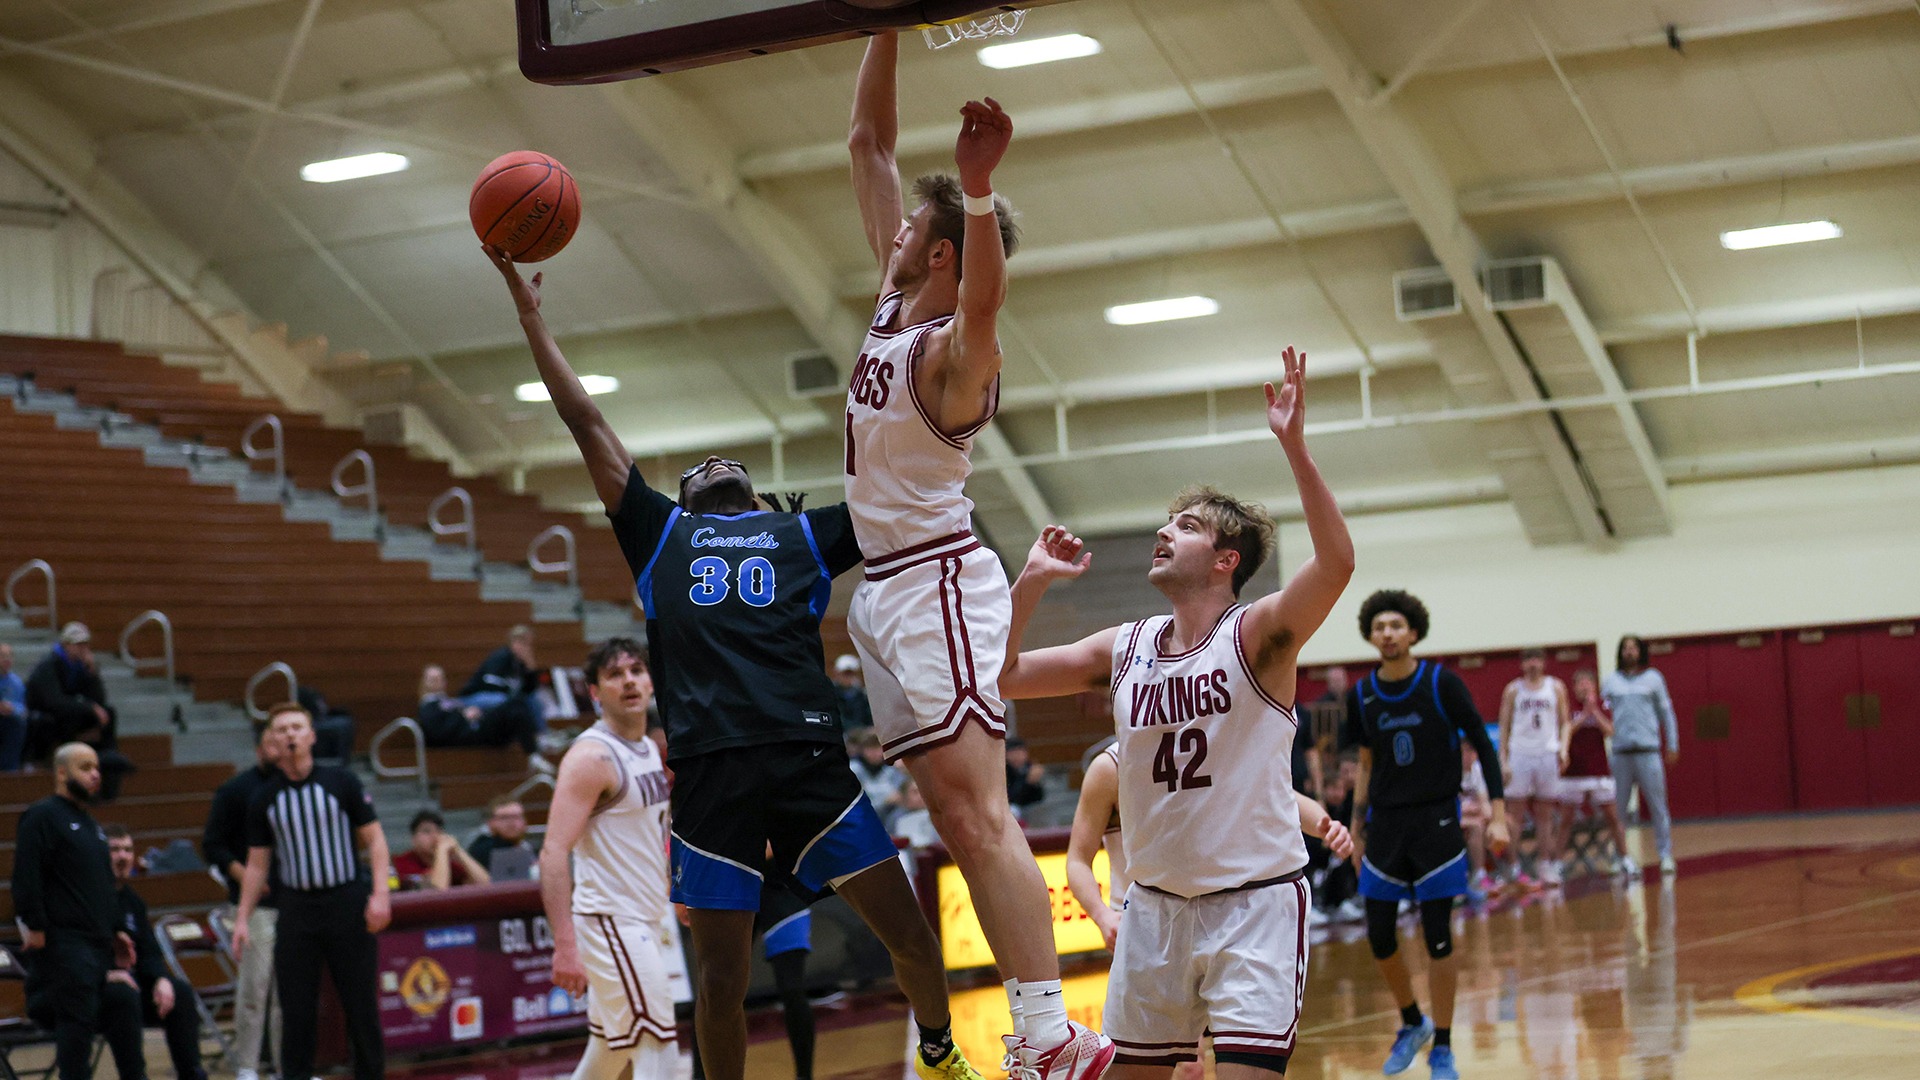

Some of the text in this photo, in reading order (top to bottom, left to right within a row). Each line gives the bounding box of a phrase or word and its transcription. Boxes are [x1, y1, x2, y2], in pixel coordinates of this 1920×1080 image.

[496, 197, 551, 252] PALDING
[848, 352, 895, 411] NGS
[690, 526, 780, 550] Comets
[688, 555, 777, 608] 30
[1130, 668, 1232, 728] VIKINGS
[1152, 727, 1213, 793] 42
[1392, 730, 1416, 767] 0
